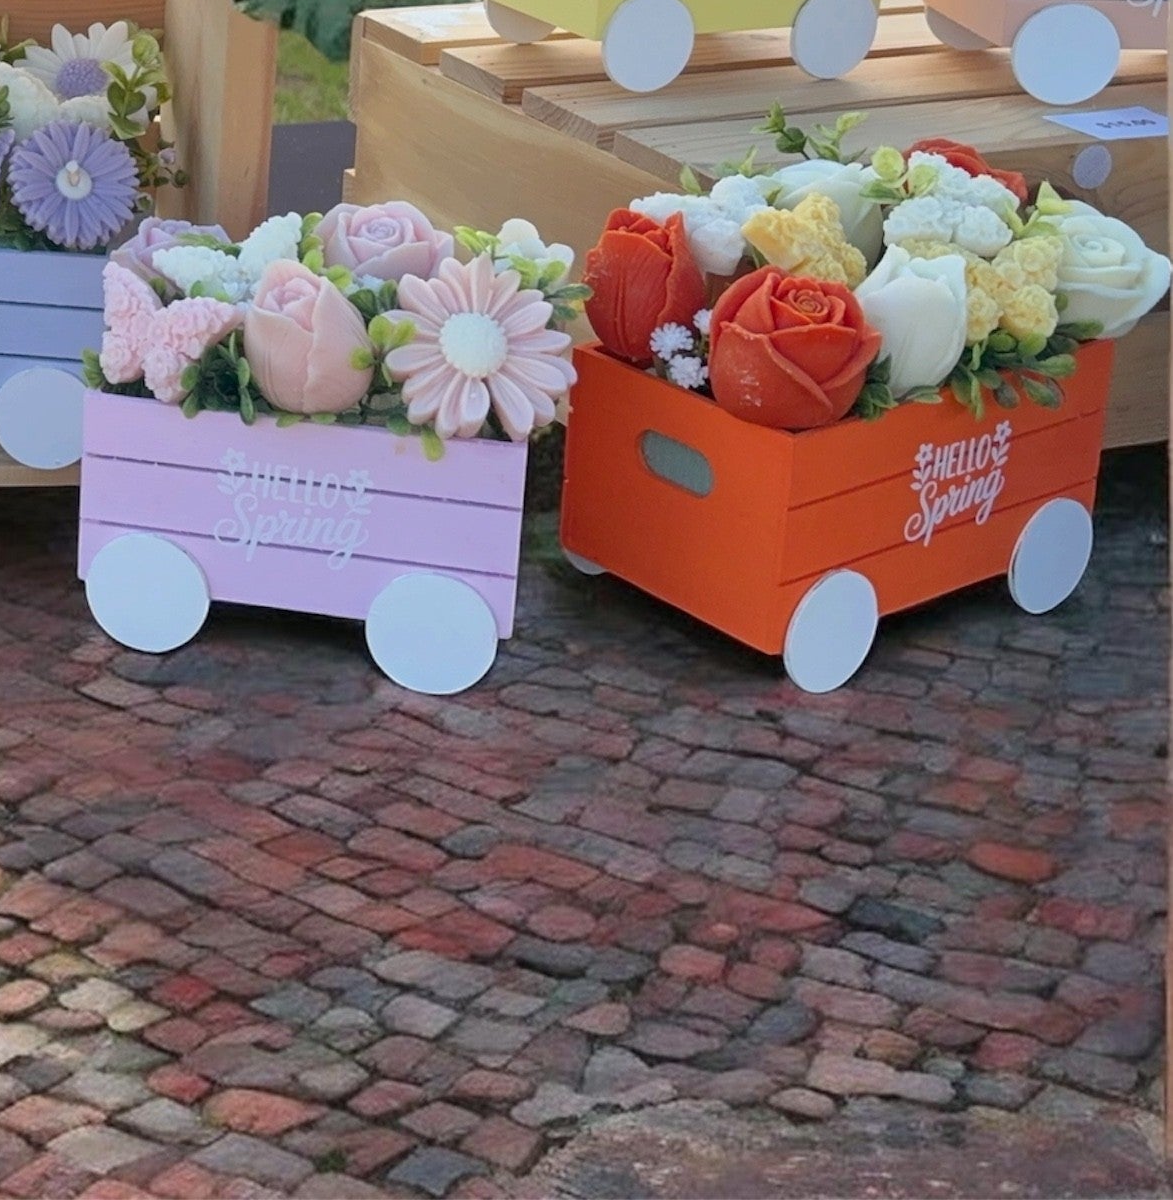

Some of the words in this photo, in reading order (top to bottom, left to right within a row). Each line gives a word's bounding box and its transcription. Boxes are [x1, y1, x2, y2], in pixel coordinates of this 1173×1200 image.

[251, 461, 340, 508] HELLO
[932, 434, 992, 481] HELLO
[214, 492, 369, 570] Spring
[904, 468, 1005, 547] Spring
